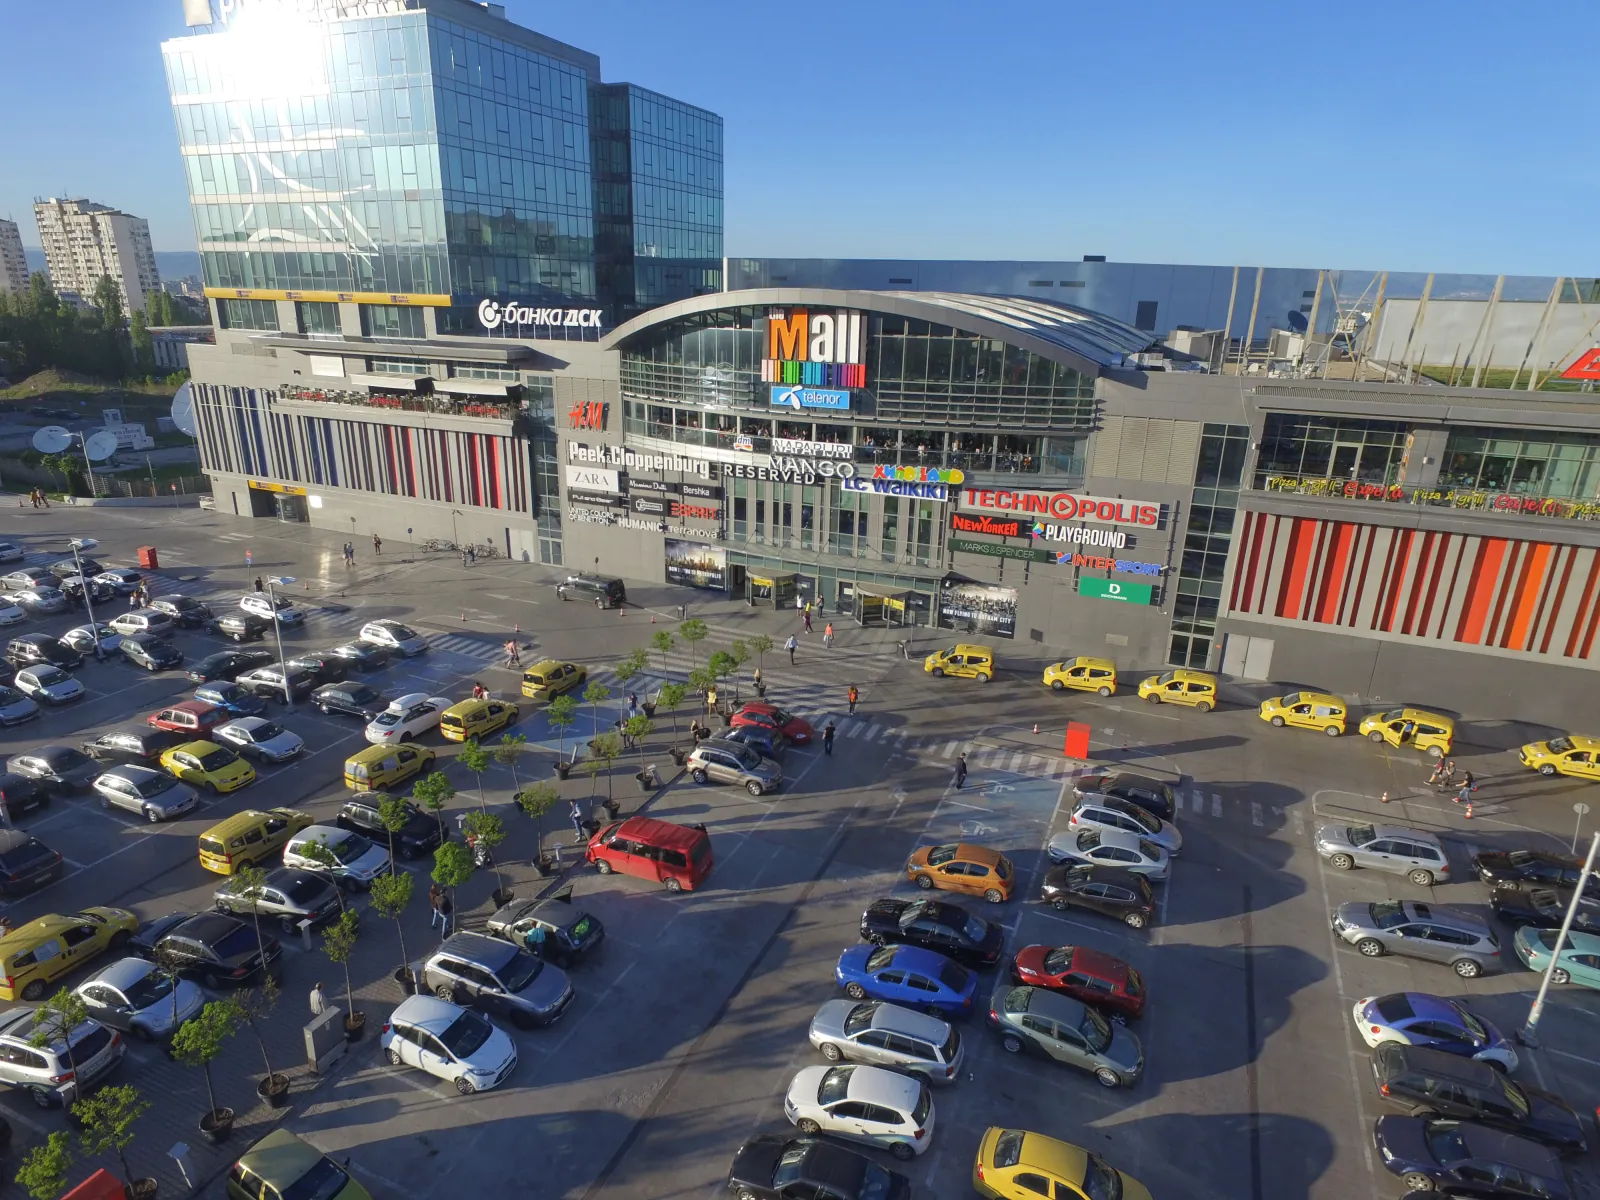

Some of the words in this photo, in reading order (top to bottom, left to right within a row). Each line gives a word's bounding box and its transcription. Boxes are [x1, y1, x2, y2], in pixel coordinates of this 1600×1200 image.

[769, 307, 861, 364] Mall
[802, 391, 842, 405] telenor
[568, 400, 604, 430] H&M
[737, 434, 752, 446] dm
[773, 440, 854, 459] NAPAPIJRI
[723, 463, 816, 486] RESERVED
[768, 455, 855, 479] MANGO
[574, 471, 610, 486] ZARA
[844, 477, 868, 492] LC
[682, 485, 710, 497] Bershka
[568, 506, 590, 517] UNITED
[590, 509, 615, 520] COLORS
[670, 502, 718, 521] ESPRIT
[964, 488, 1158, 526] TECHNOPOLIS
[618, 517, 664, 533] HUMANIC
[1045, 525, 1127, 550] PLAYGROUND
[960, 542, 990, 554] MARKS
[996, 546, 1036, 560] SPENCER
[1071, 553, 1162, 577] INTERSPORT
[1109, 583, 1121, 595] D
